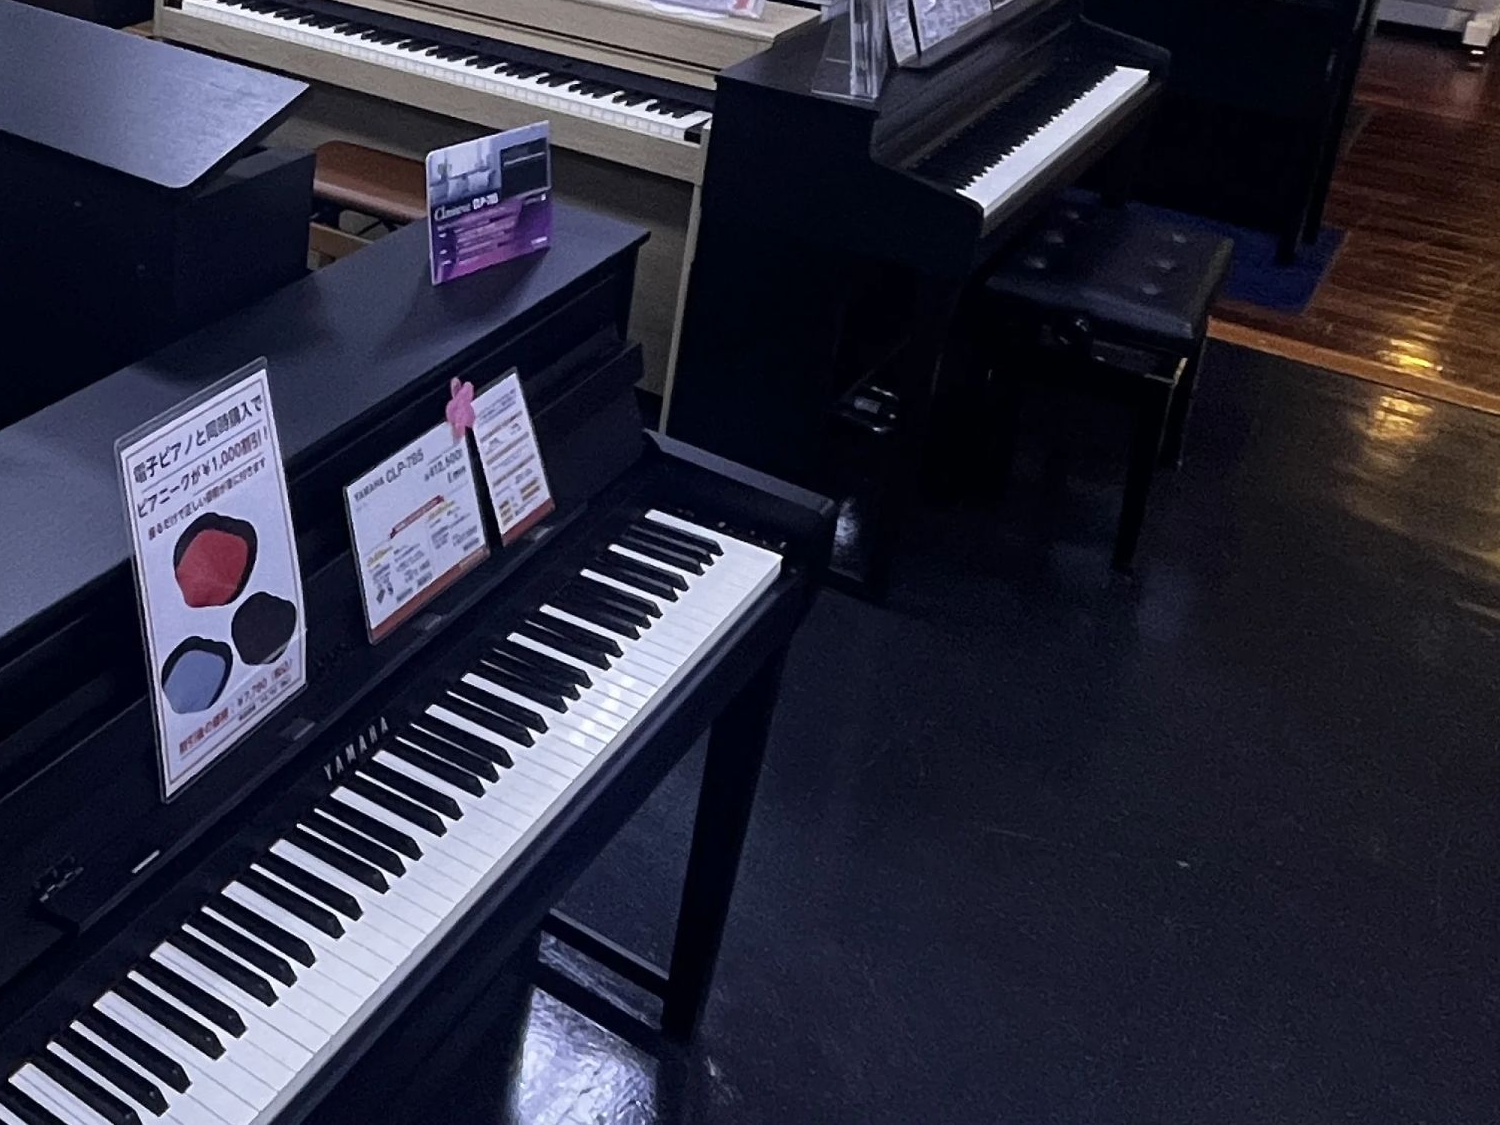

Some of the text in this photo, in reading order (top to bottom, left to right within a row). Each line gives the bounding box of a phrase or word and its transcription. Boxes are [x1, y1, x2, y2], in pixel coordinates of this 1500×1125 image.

[133, 394, 264, 484] 電子ピアノと同時購入で
[323, 715, 389, 782] YAMAHA
